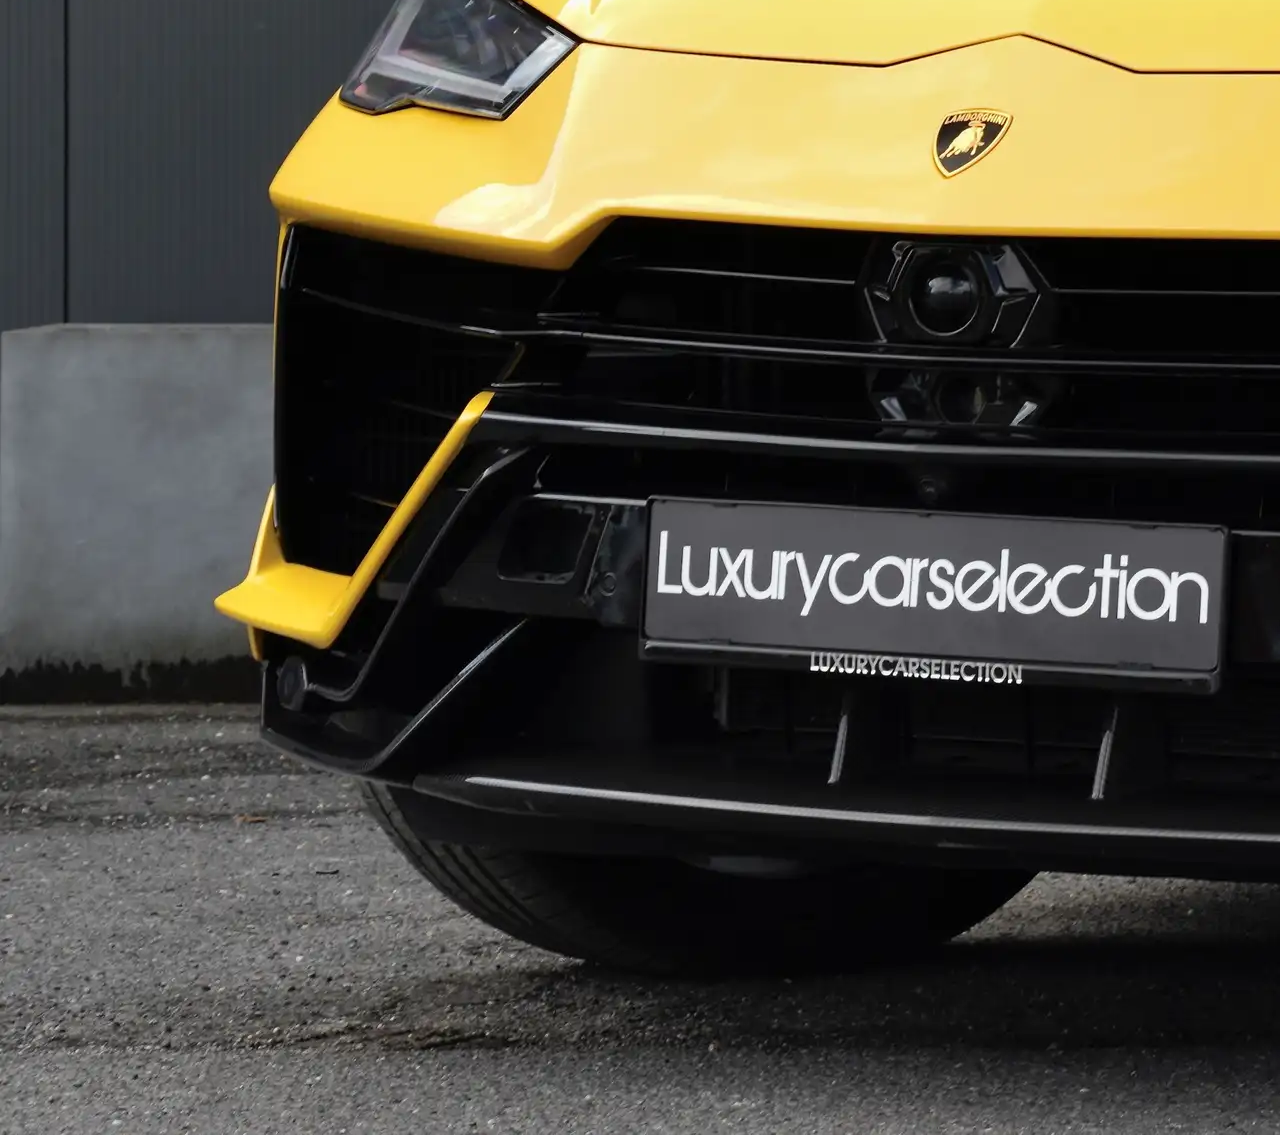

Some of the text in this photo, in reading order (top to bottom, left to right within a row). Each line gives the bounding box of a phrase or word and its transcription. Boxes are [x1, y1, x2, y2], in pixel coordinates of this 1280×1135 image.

[944, 112, 1007, 126] LAMBORGHINI
[656, 530, 1209, 624] Luxurycarselection
[809, 651, 1023, 684] LUXURYCARSELECTION
